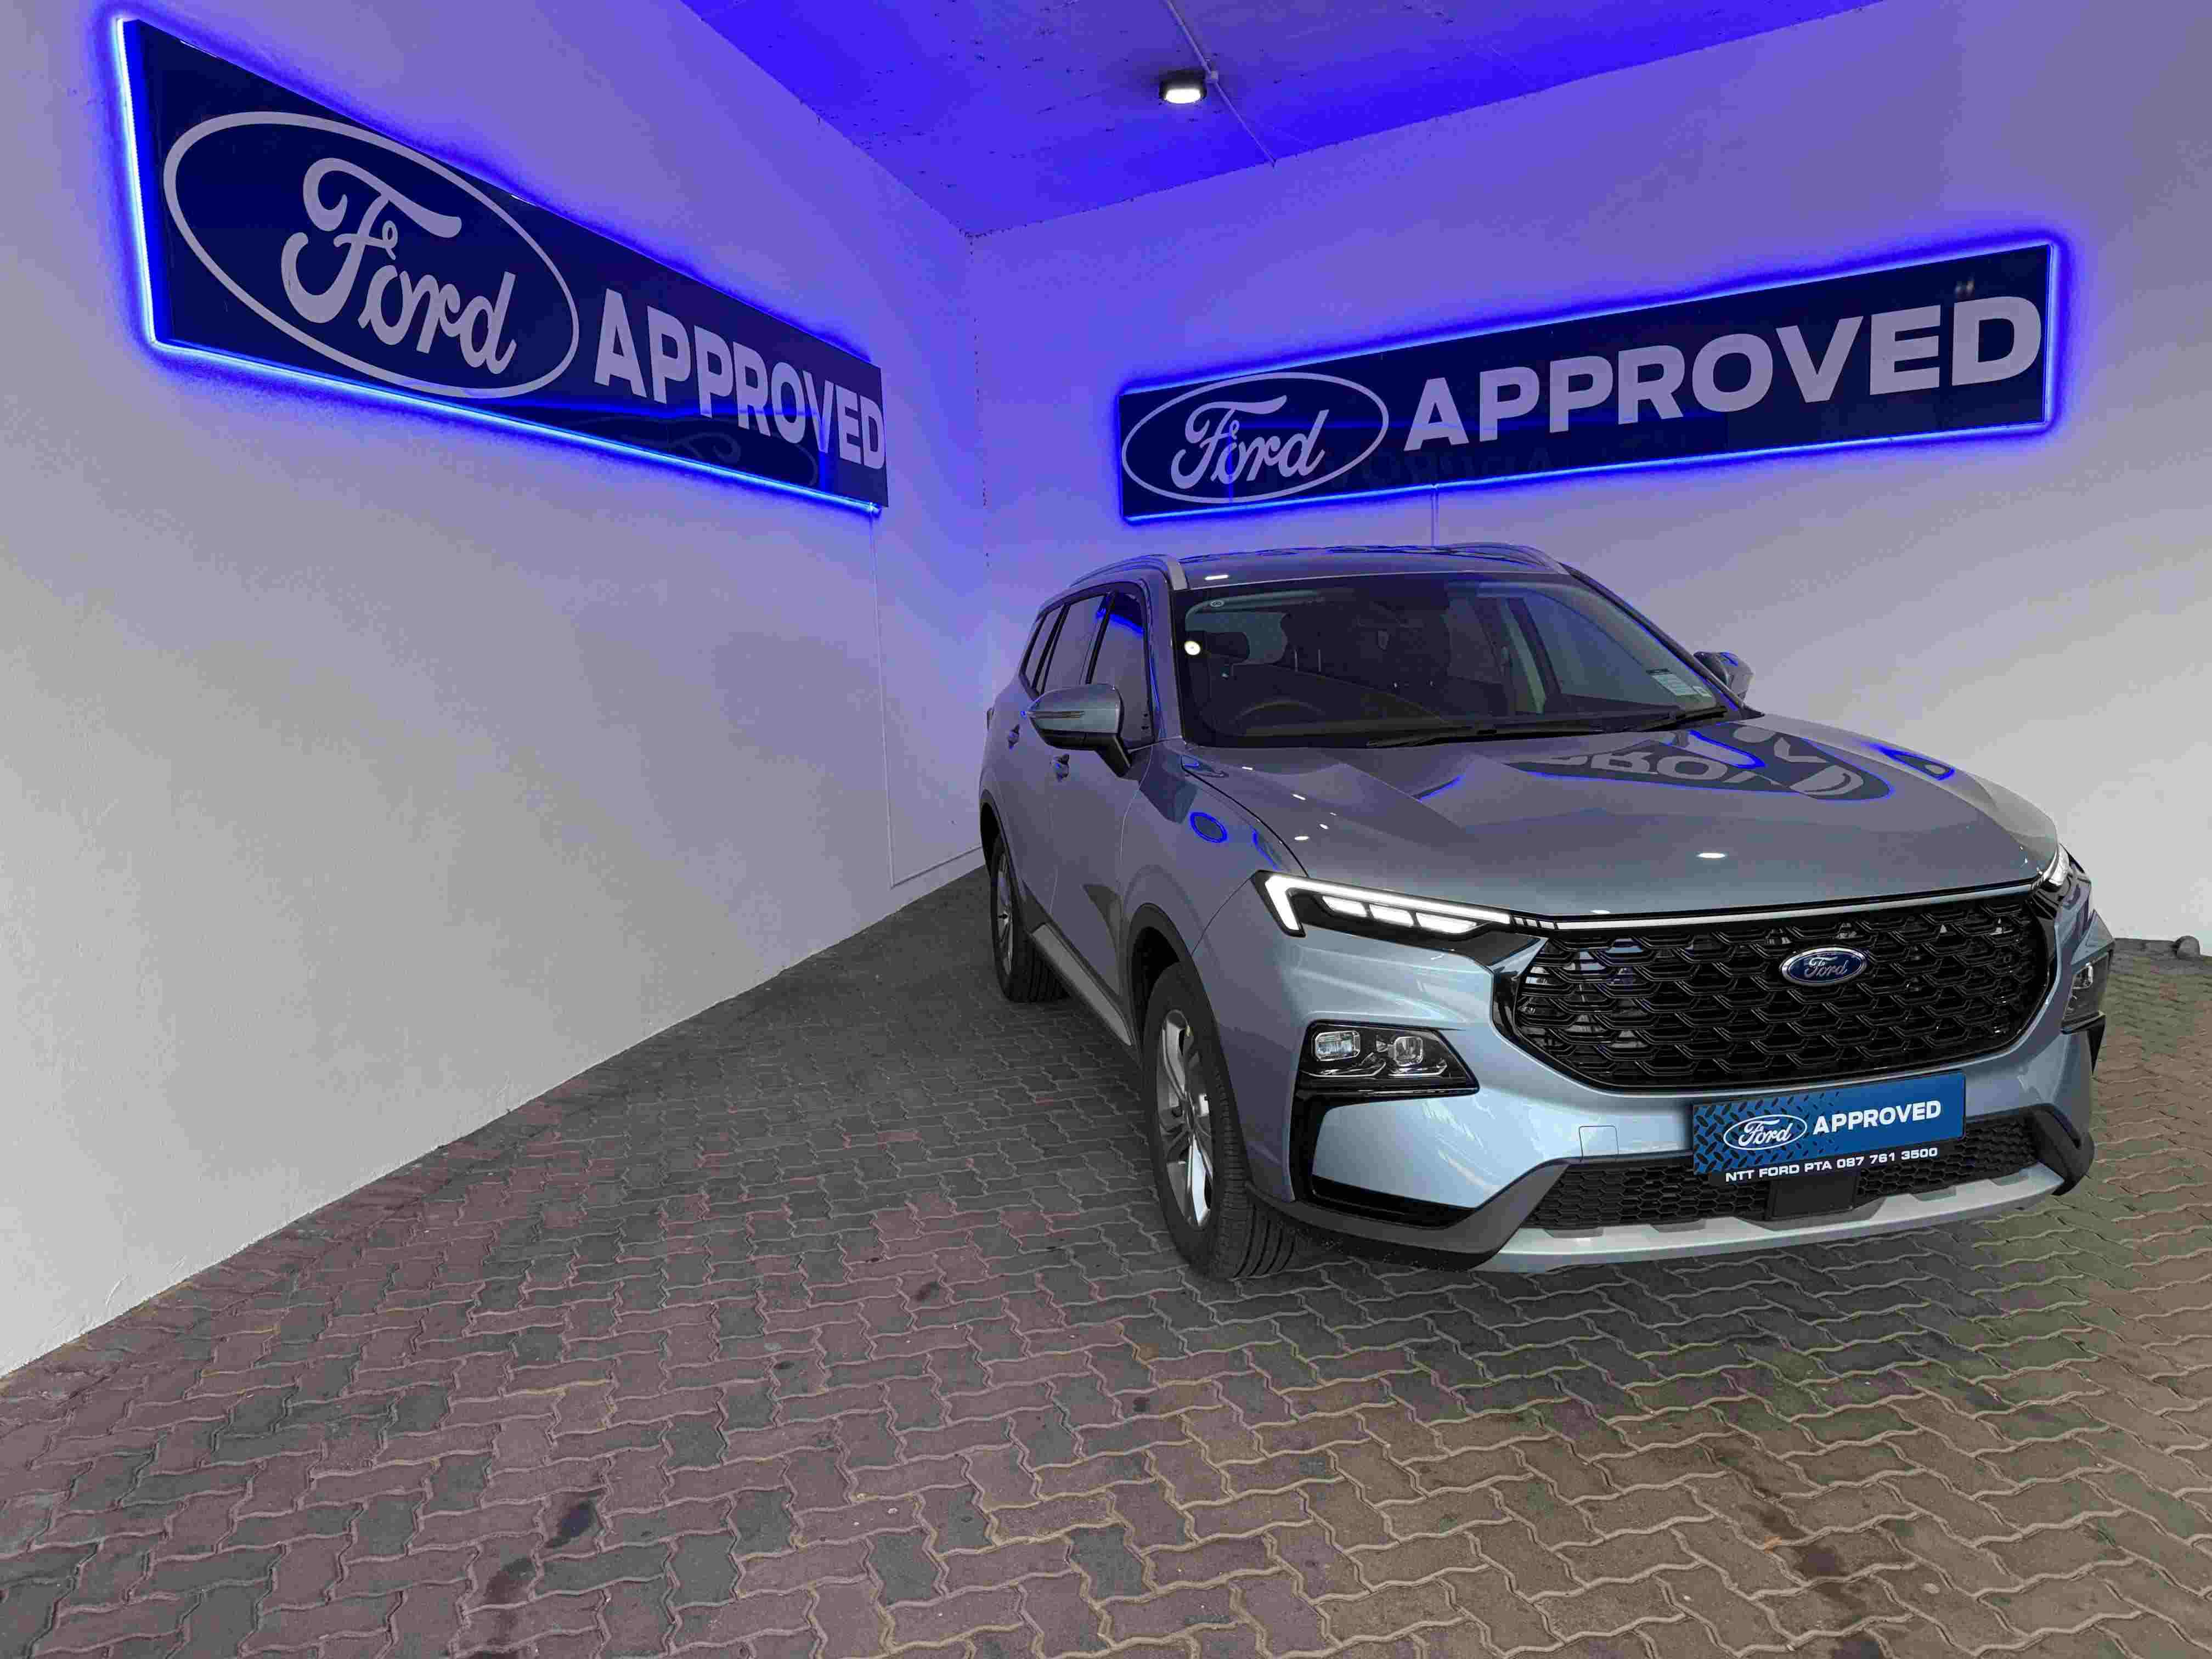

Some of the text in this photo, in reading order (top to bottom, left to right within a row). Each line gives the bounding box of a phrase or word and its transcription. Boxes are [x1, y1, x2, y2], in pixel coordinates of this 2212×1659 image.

[280, 157, 886, 470] Ford APPROVED
[1170, 295, 2042, 490] Ford APPROVED
[1803, 956, 1849, 978] Ford
[1738, 1100, 1942, 1147] Ford APPROVED
[1725, 1147, 1938, 1182] NTT FORD PTA 087 761 3500
